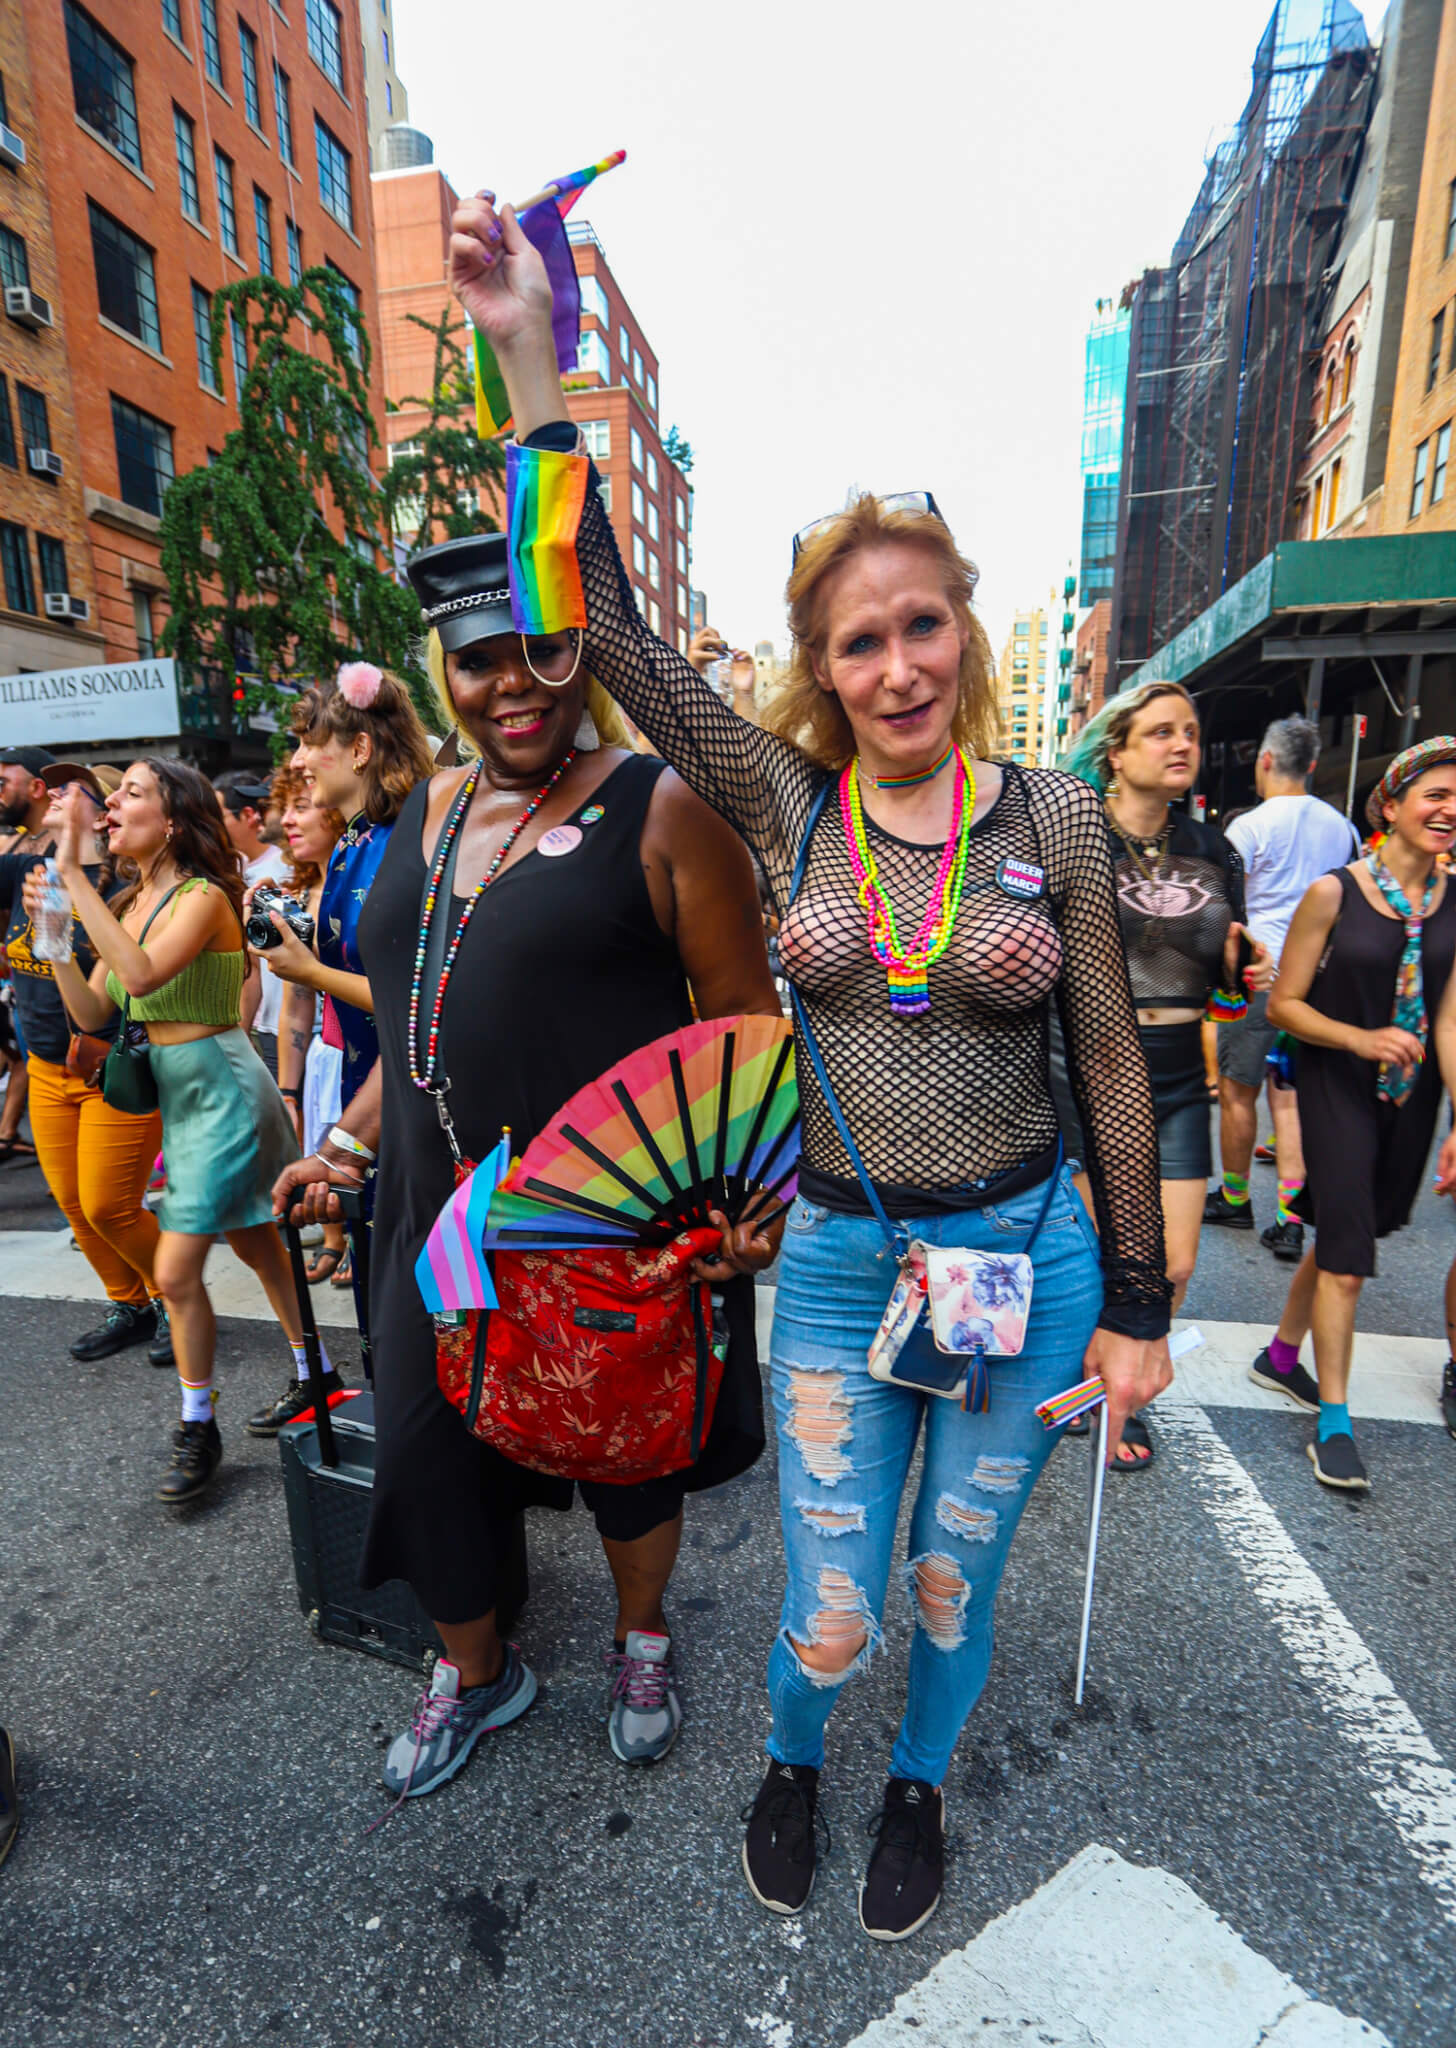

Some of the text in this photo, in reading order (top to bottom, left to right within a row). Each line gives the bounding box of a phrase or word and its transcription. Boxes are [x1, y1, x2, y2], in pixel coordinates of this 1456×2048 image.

[0, 667, 165, 703] ILLIAMS SONOMA
[1006, 859, 1044, 879] QUEER
[1002, 874, 1042, 894] MARCH
